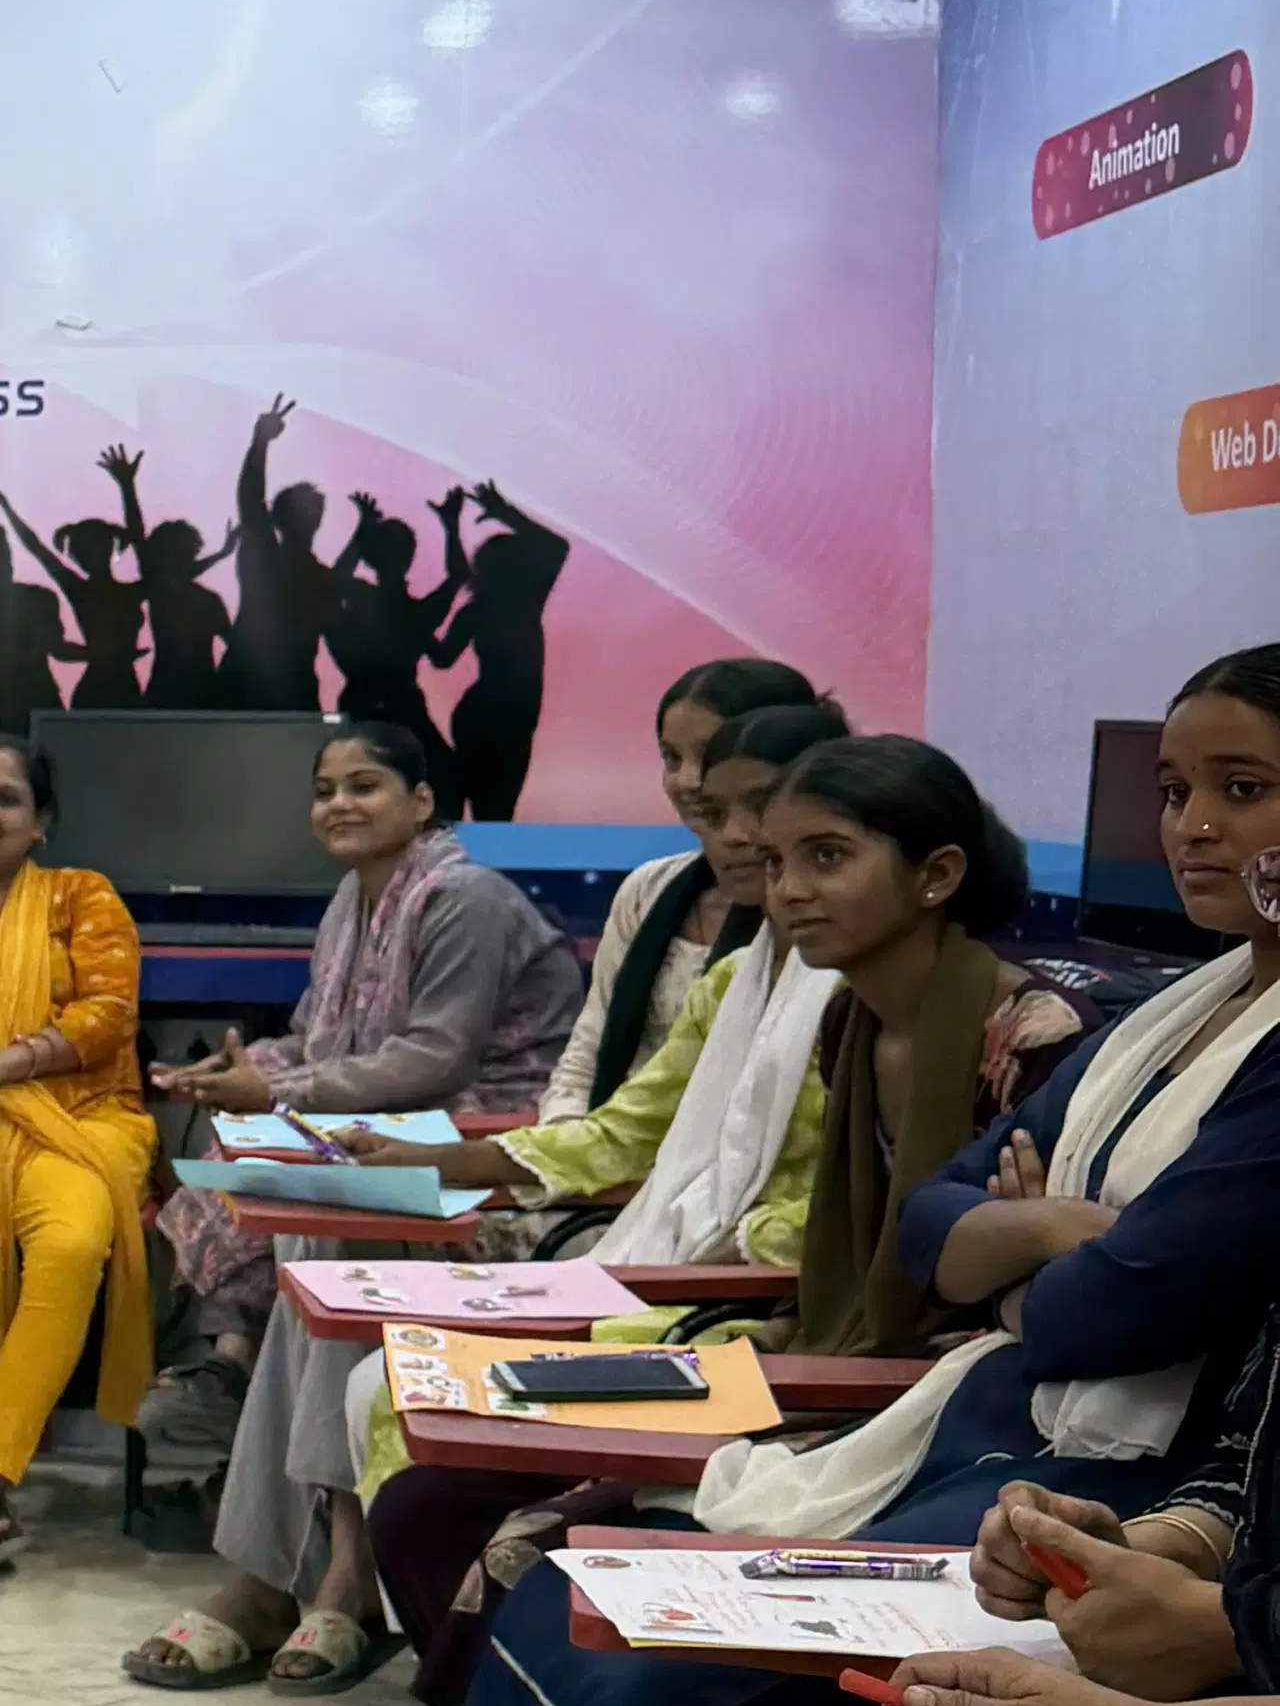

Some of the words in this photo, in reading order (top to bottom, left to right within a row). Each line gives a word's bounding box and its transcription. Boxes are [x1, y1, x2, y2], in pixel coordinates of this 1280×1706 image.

[1088, 121, 1180, 190] Animation
[1210, 419, 1257, 472] Web
[1262, 418, 1280, 464] D
